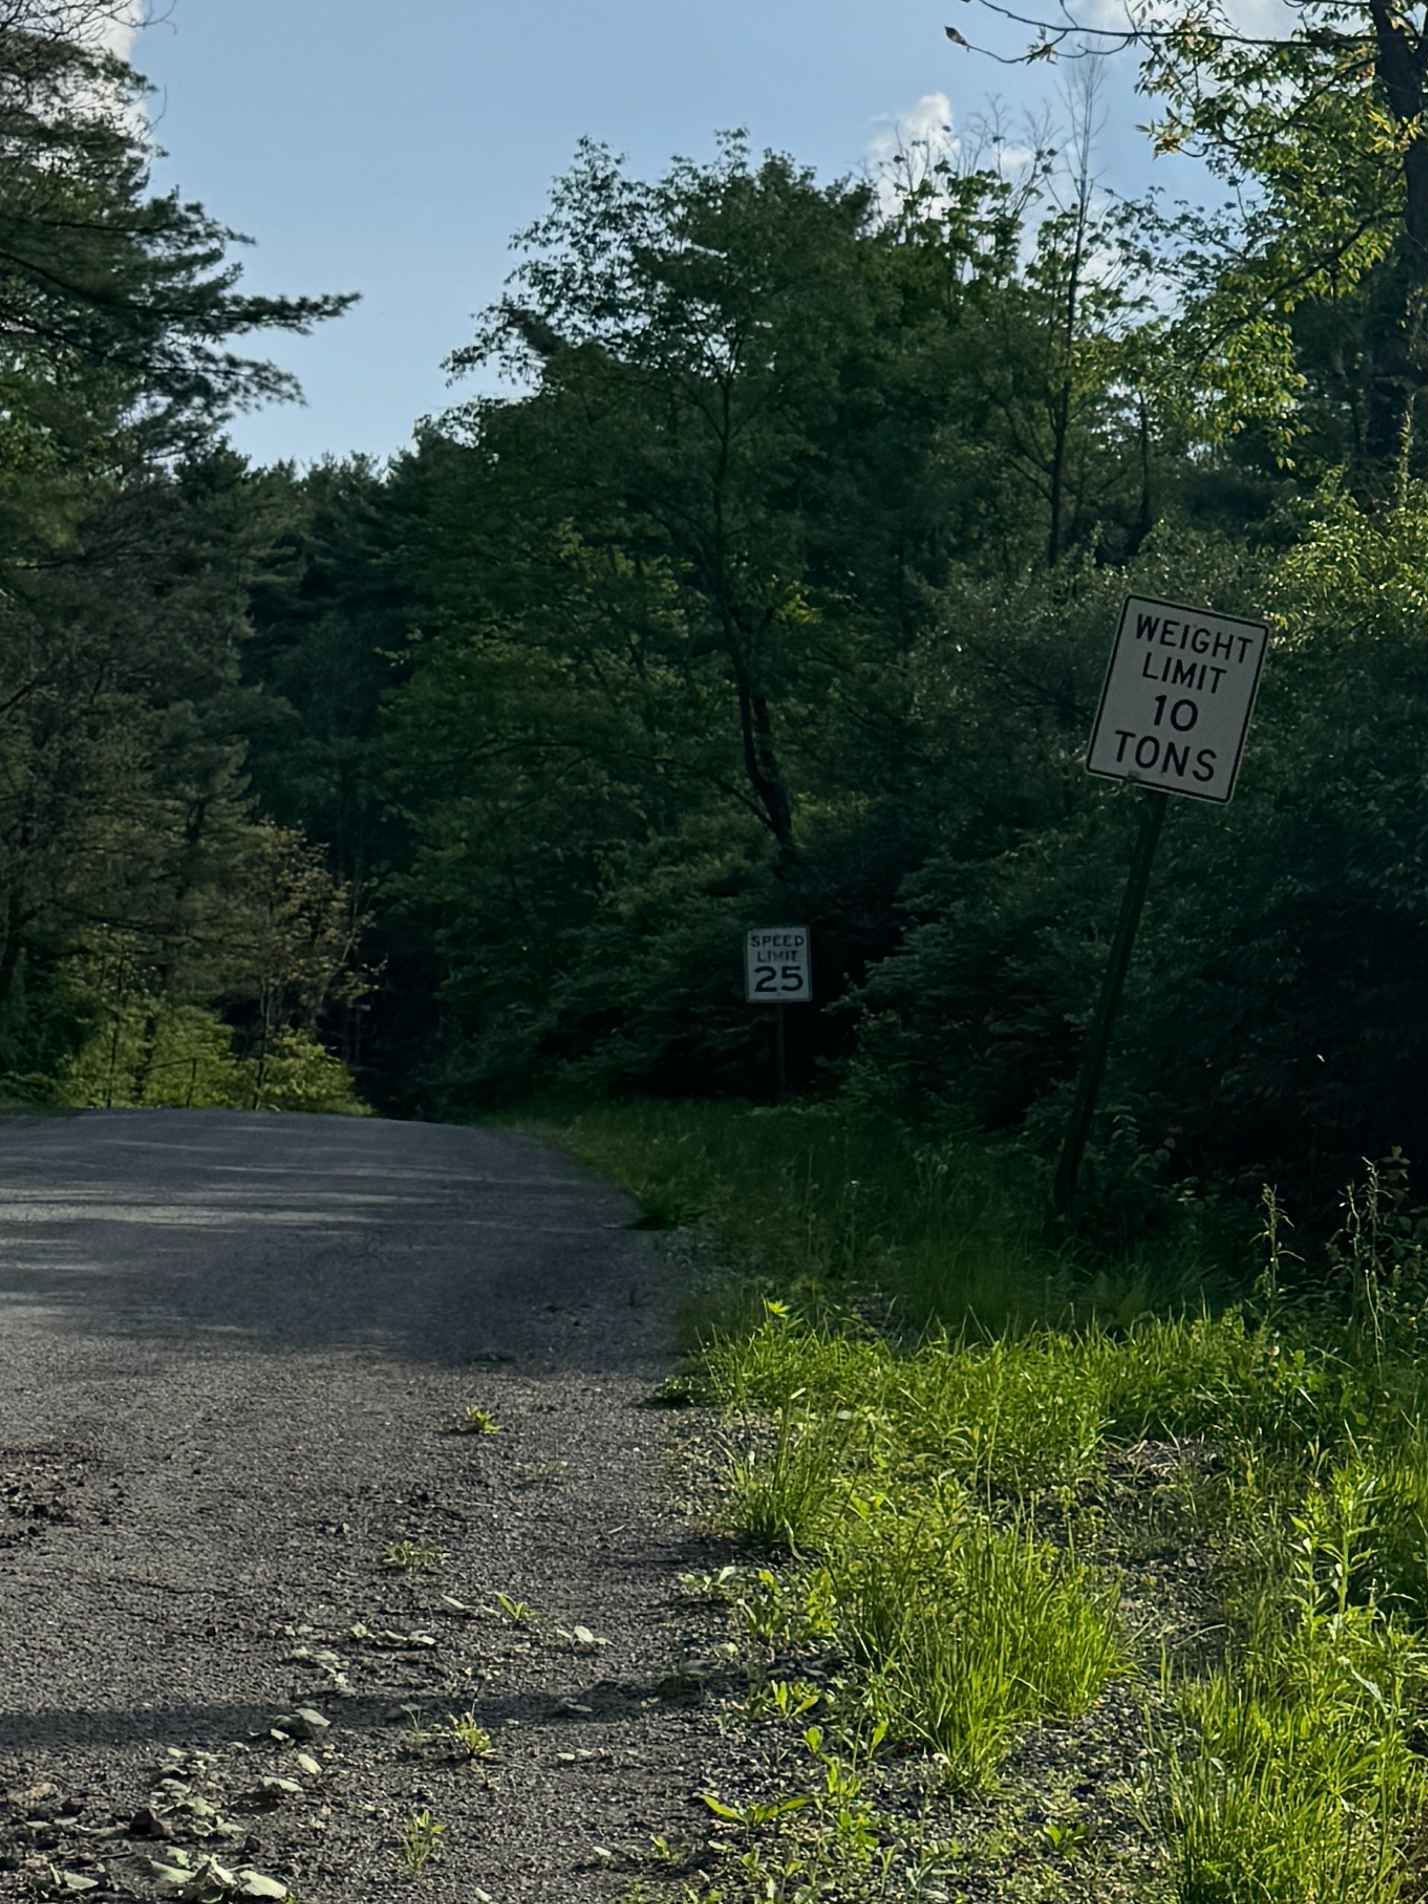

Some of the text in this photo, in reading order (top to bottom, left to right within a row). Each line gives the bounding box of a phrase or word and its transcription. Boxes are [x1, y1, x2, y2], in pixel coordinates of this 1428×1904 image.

[1135, 613, 1253, 664] WEIGHT
[1142, 652, 1227, 694] LIMIT
[1154, 694, 1199, 732] 10
[1115, 730, 1217, 782] TONS
[751, 935, 805, 947] SPEED
[757, 950, 799, 962] LIMIT
[754, 965, 803, 992] 25
